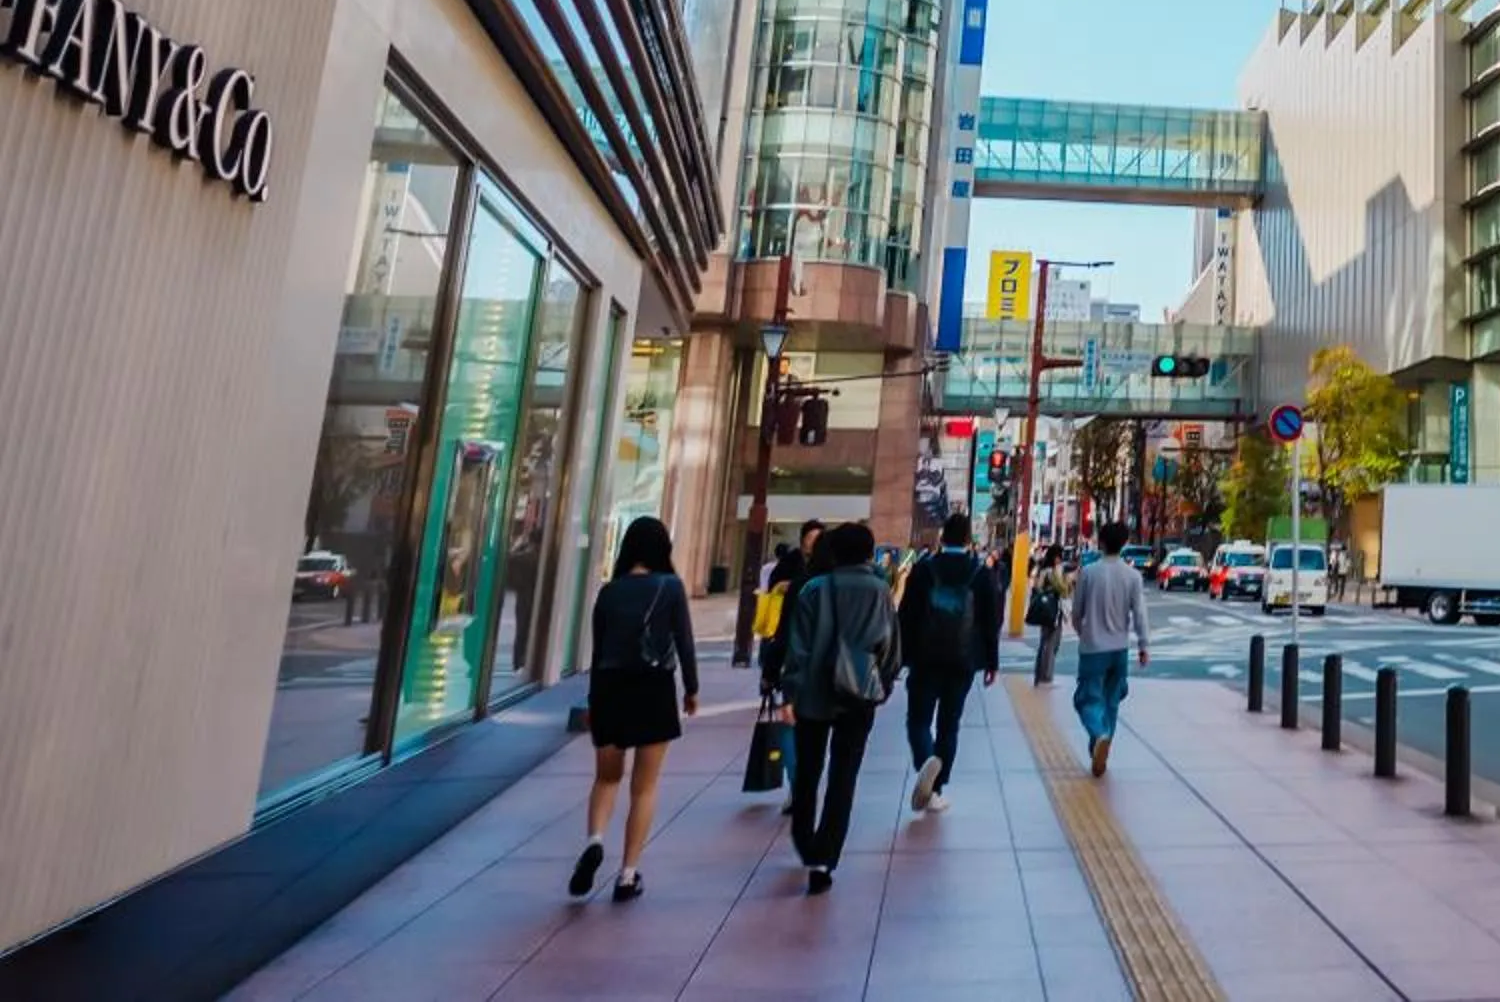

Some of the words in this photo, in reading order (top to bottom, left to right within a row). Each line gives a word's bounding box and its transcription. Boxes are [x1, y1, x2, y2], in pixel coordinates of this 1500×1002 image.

[1000, 258, 1021, 320] プロミ
[1455, 388, 1465, 405] P
